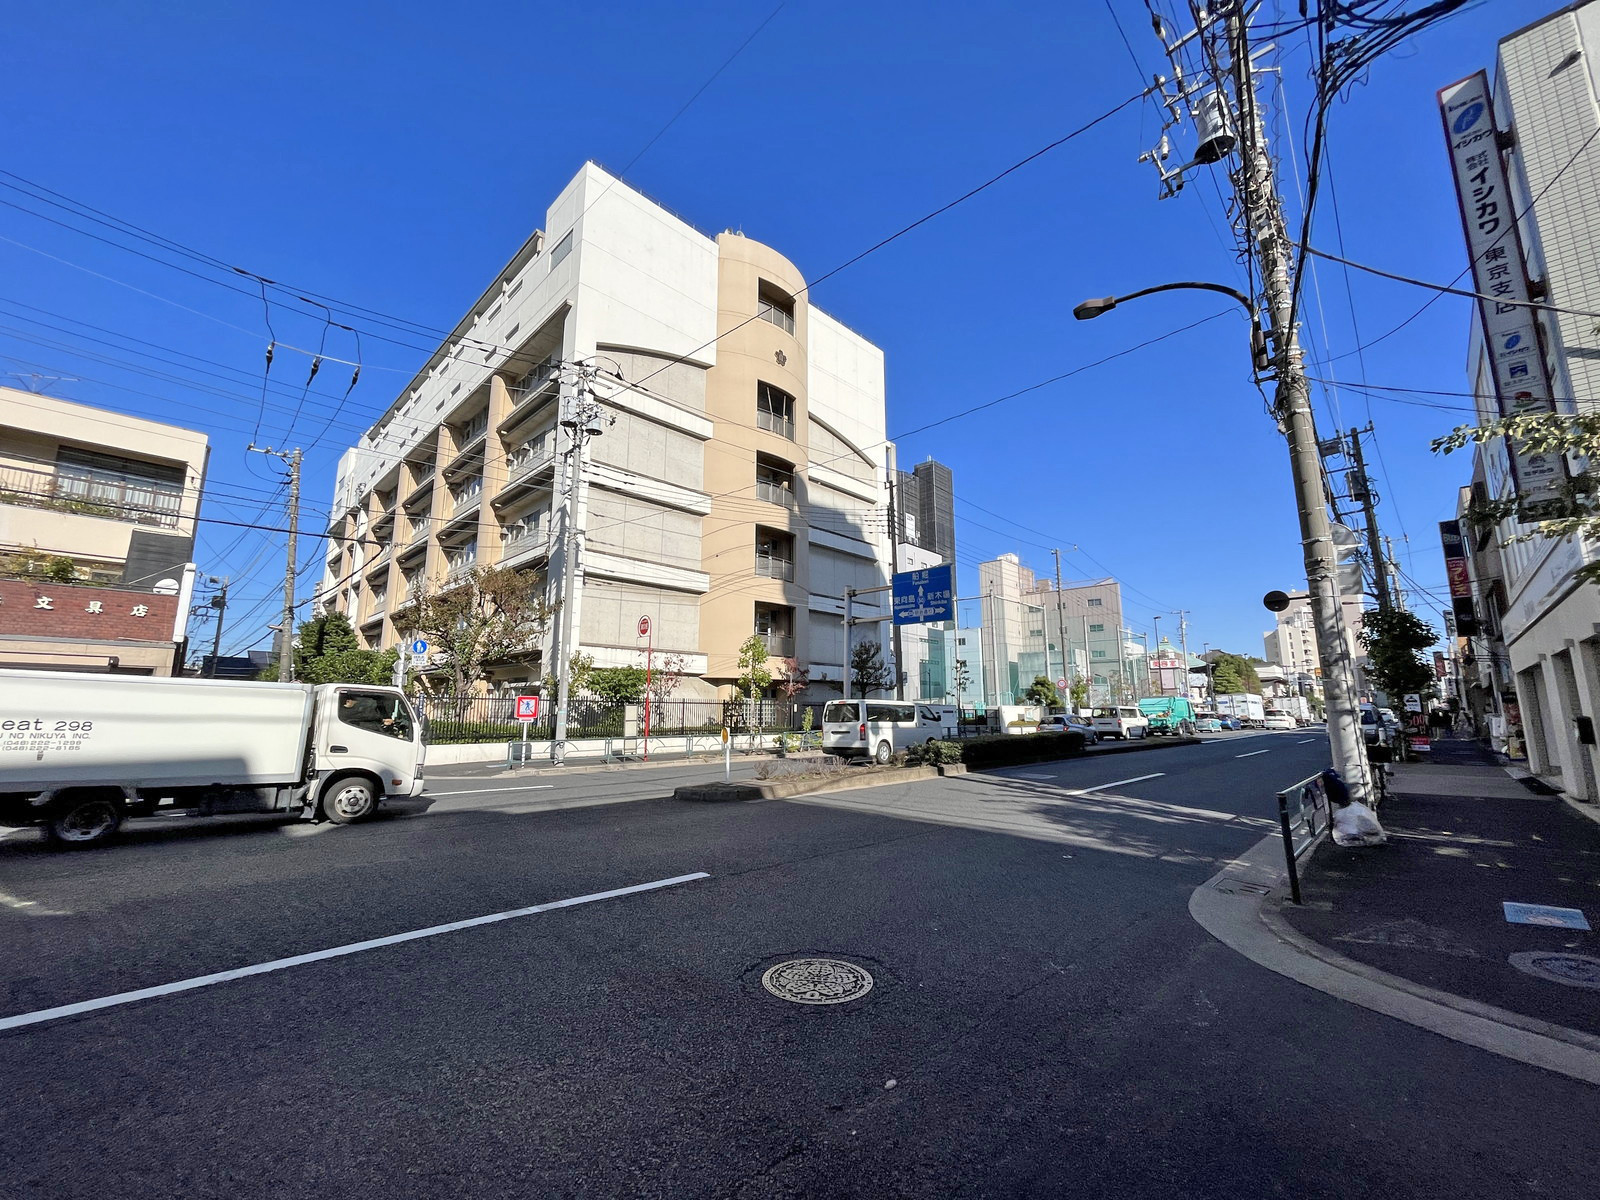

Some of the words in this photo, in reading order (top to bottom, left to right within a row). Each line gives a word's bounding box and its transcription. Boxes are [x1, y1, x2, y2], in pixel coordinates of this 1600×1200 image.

[1454, 129, 1493, 150] イシカワ
[1470, 166, 1500, 236] イシカワ
[0, 595, 149, 618] 文具店
[54, 721, 93, 732] 298
